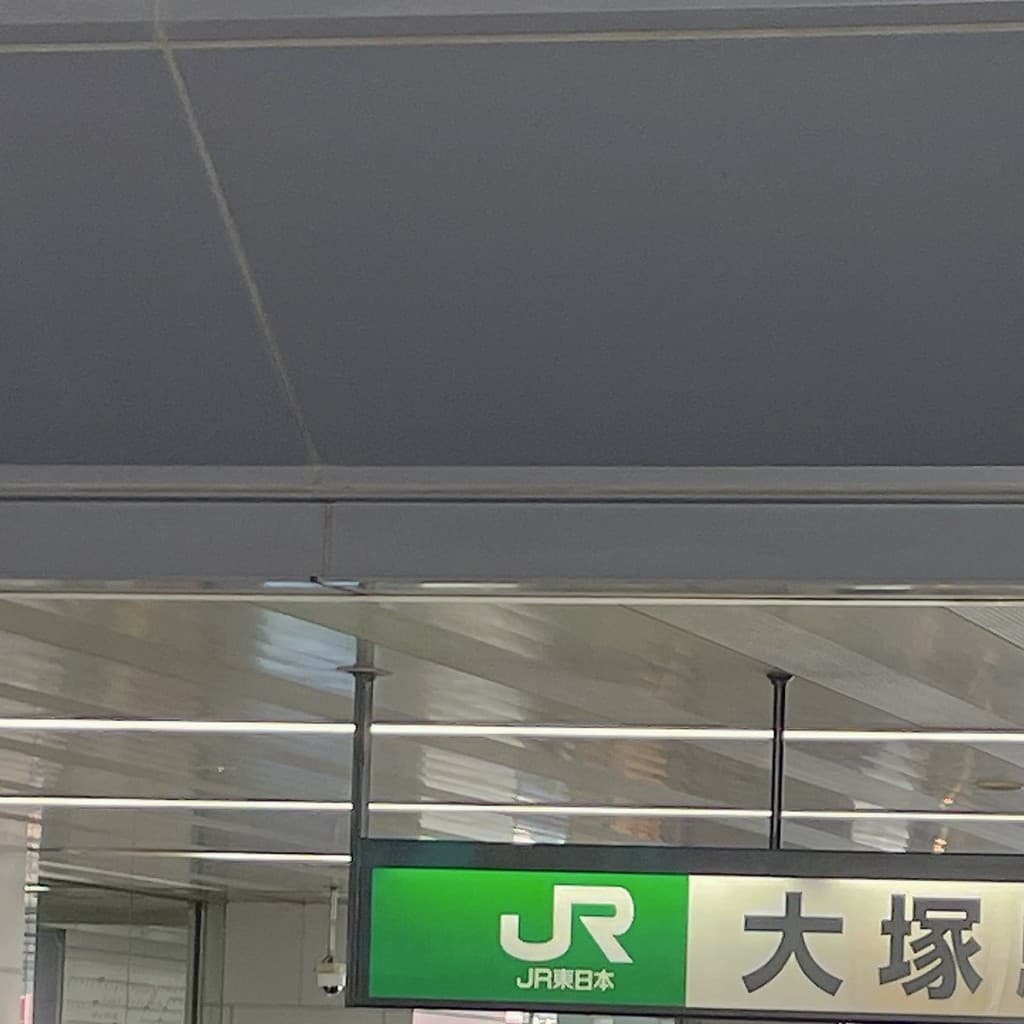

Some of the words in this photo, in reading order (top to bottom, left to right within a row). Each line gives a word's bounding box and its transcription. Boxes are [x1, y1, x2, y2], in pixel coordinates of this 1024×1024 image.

[499, 885, 635, 964] JR
[516, 967, 614, 992] JR東日本
